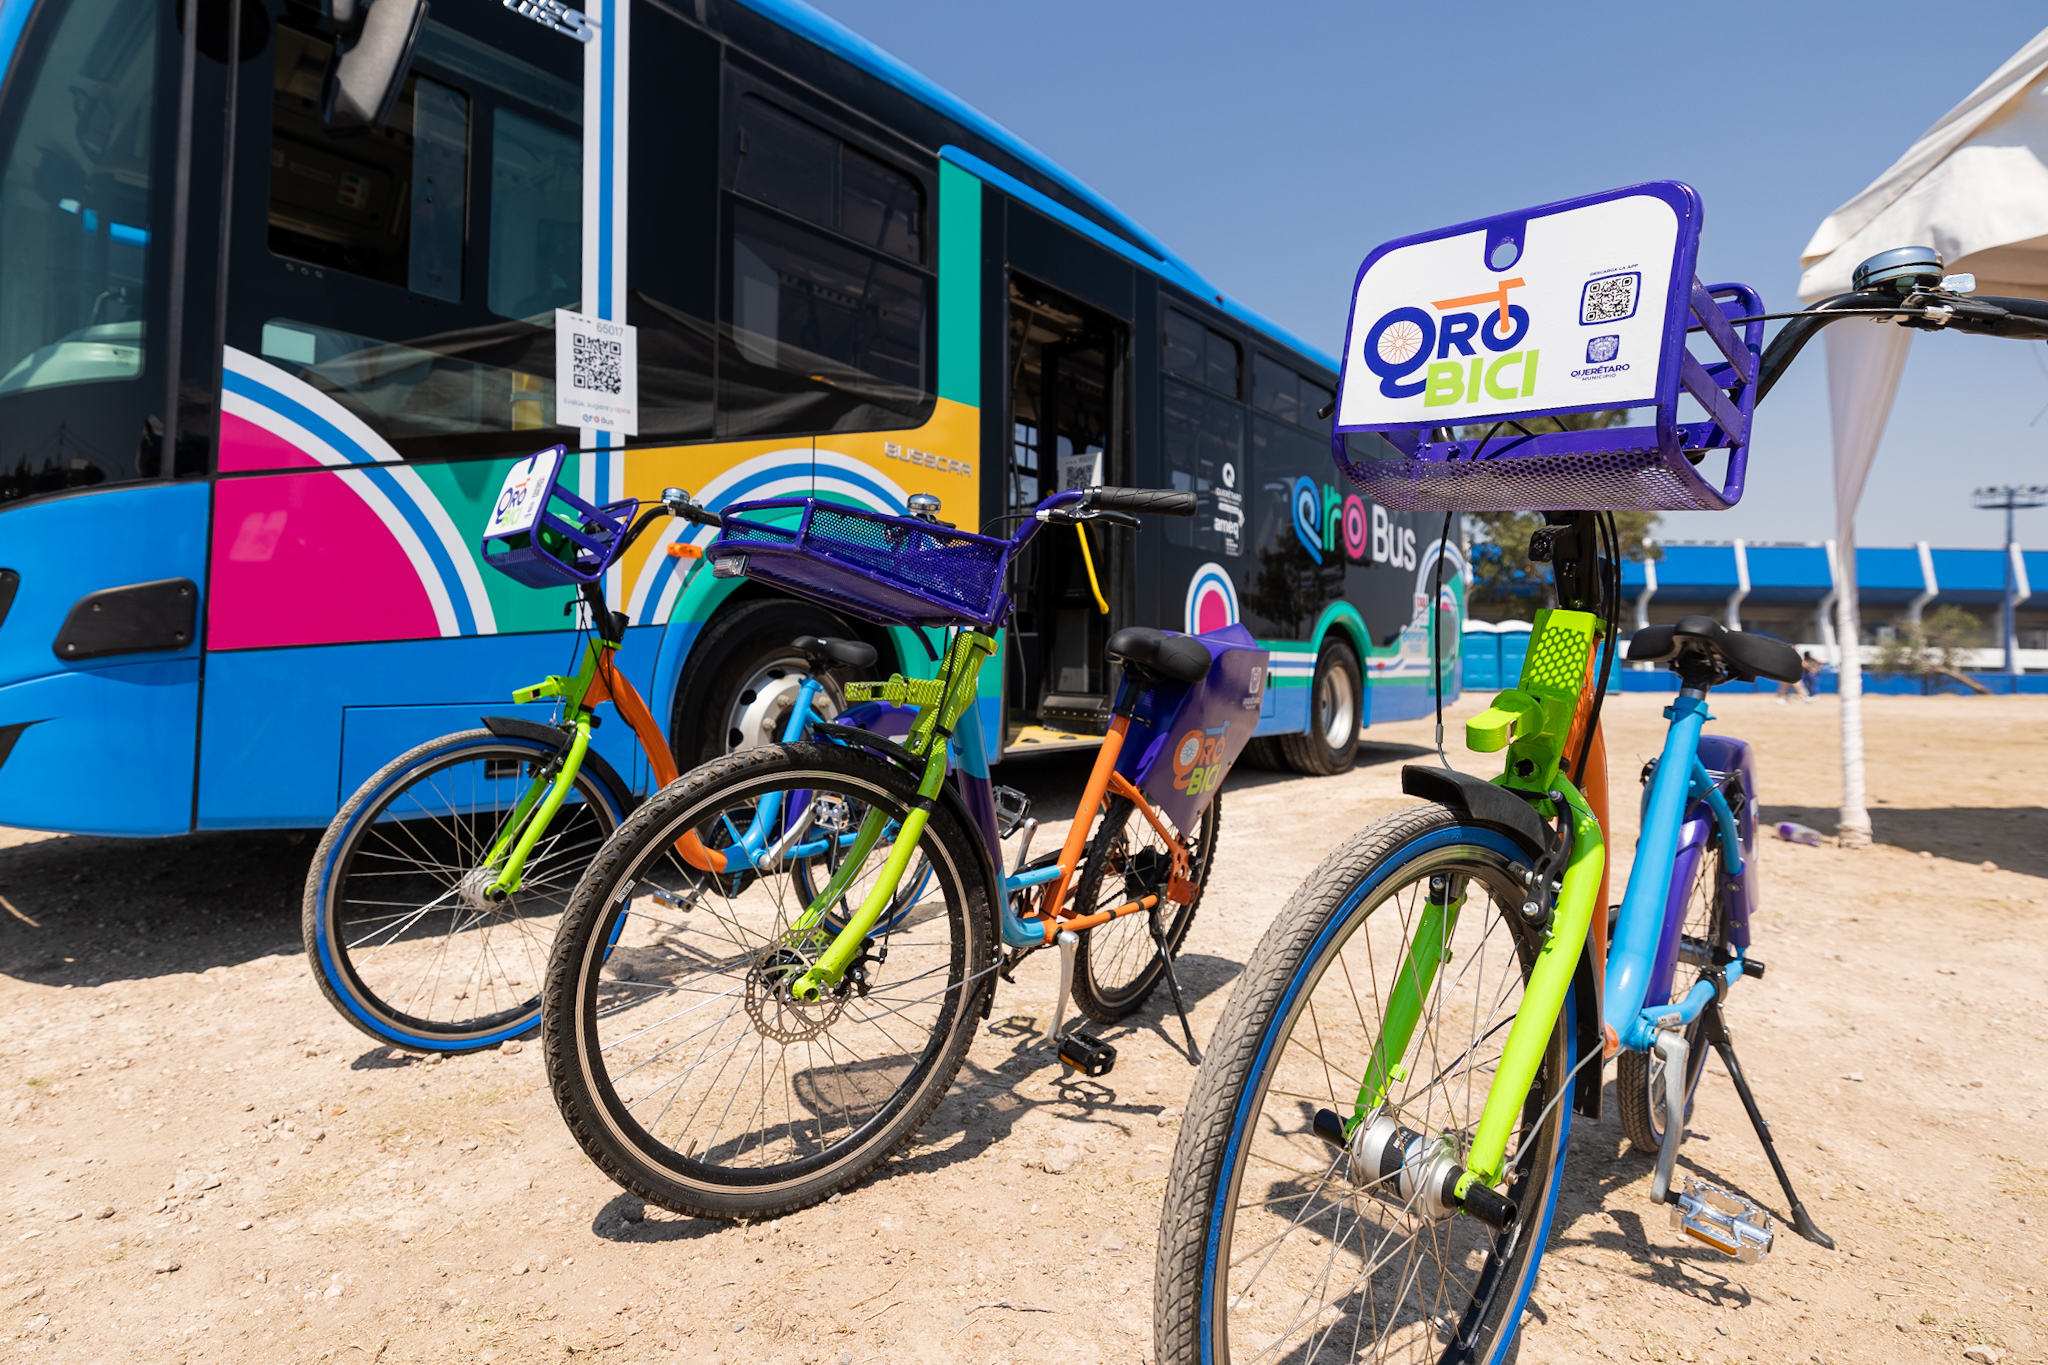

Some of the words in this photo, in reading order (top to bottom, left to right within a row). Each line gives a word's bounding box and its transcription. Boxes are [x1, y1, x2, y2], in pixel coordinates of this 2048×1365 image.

[596, 322, 624, 337] 65017
[1364, 303, 1530, 399] QRO
[1423, 349, 1540, 408] BICI
[1570, 363, 1630, 378] QUERÉTARO
[600, 416, 614, 426] Bus
[884, 441, 972, 478] BUSSCAR
[1372, 504, 1416, 572] Bus
[1173, 729, 1226, 790] QRO
[1186, 763, 1222, 796] BICI
